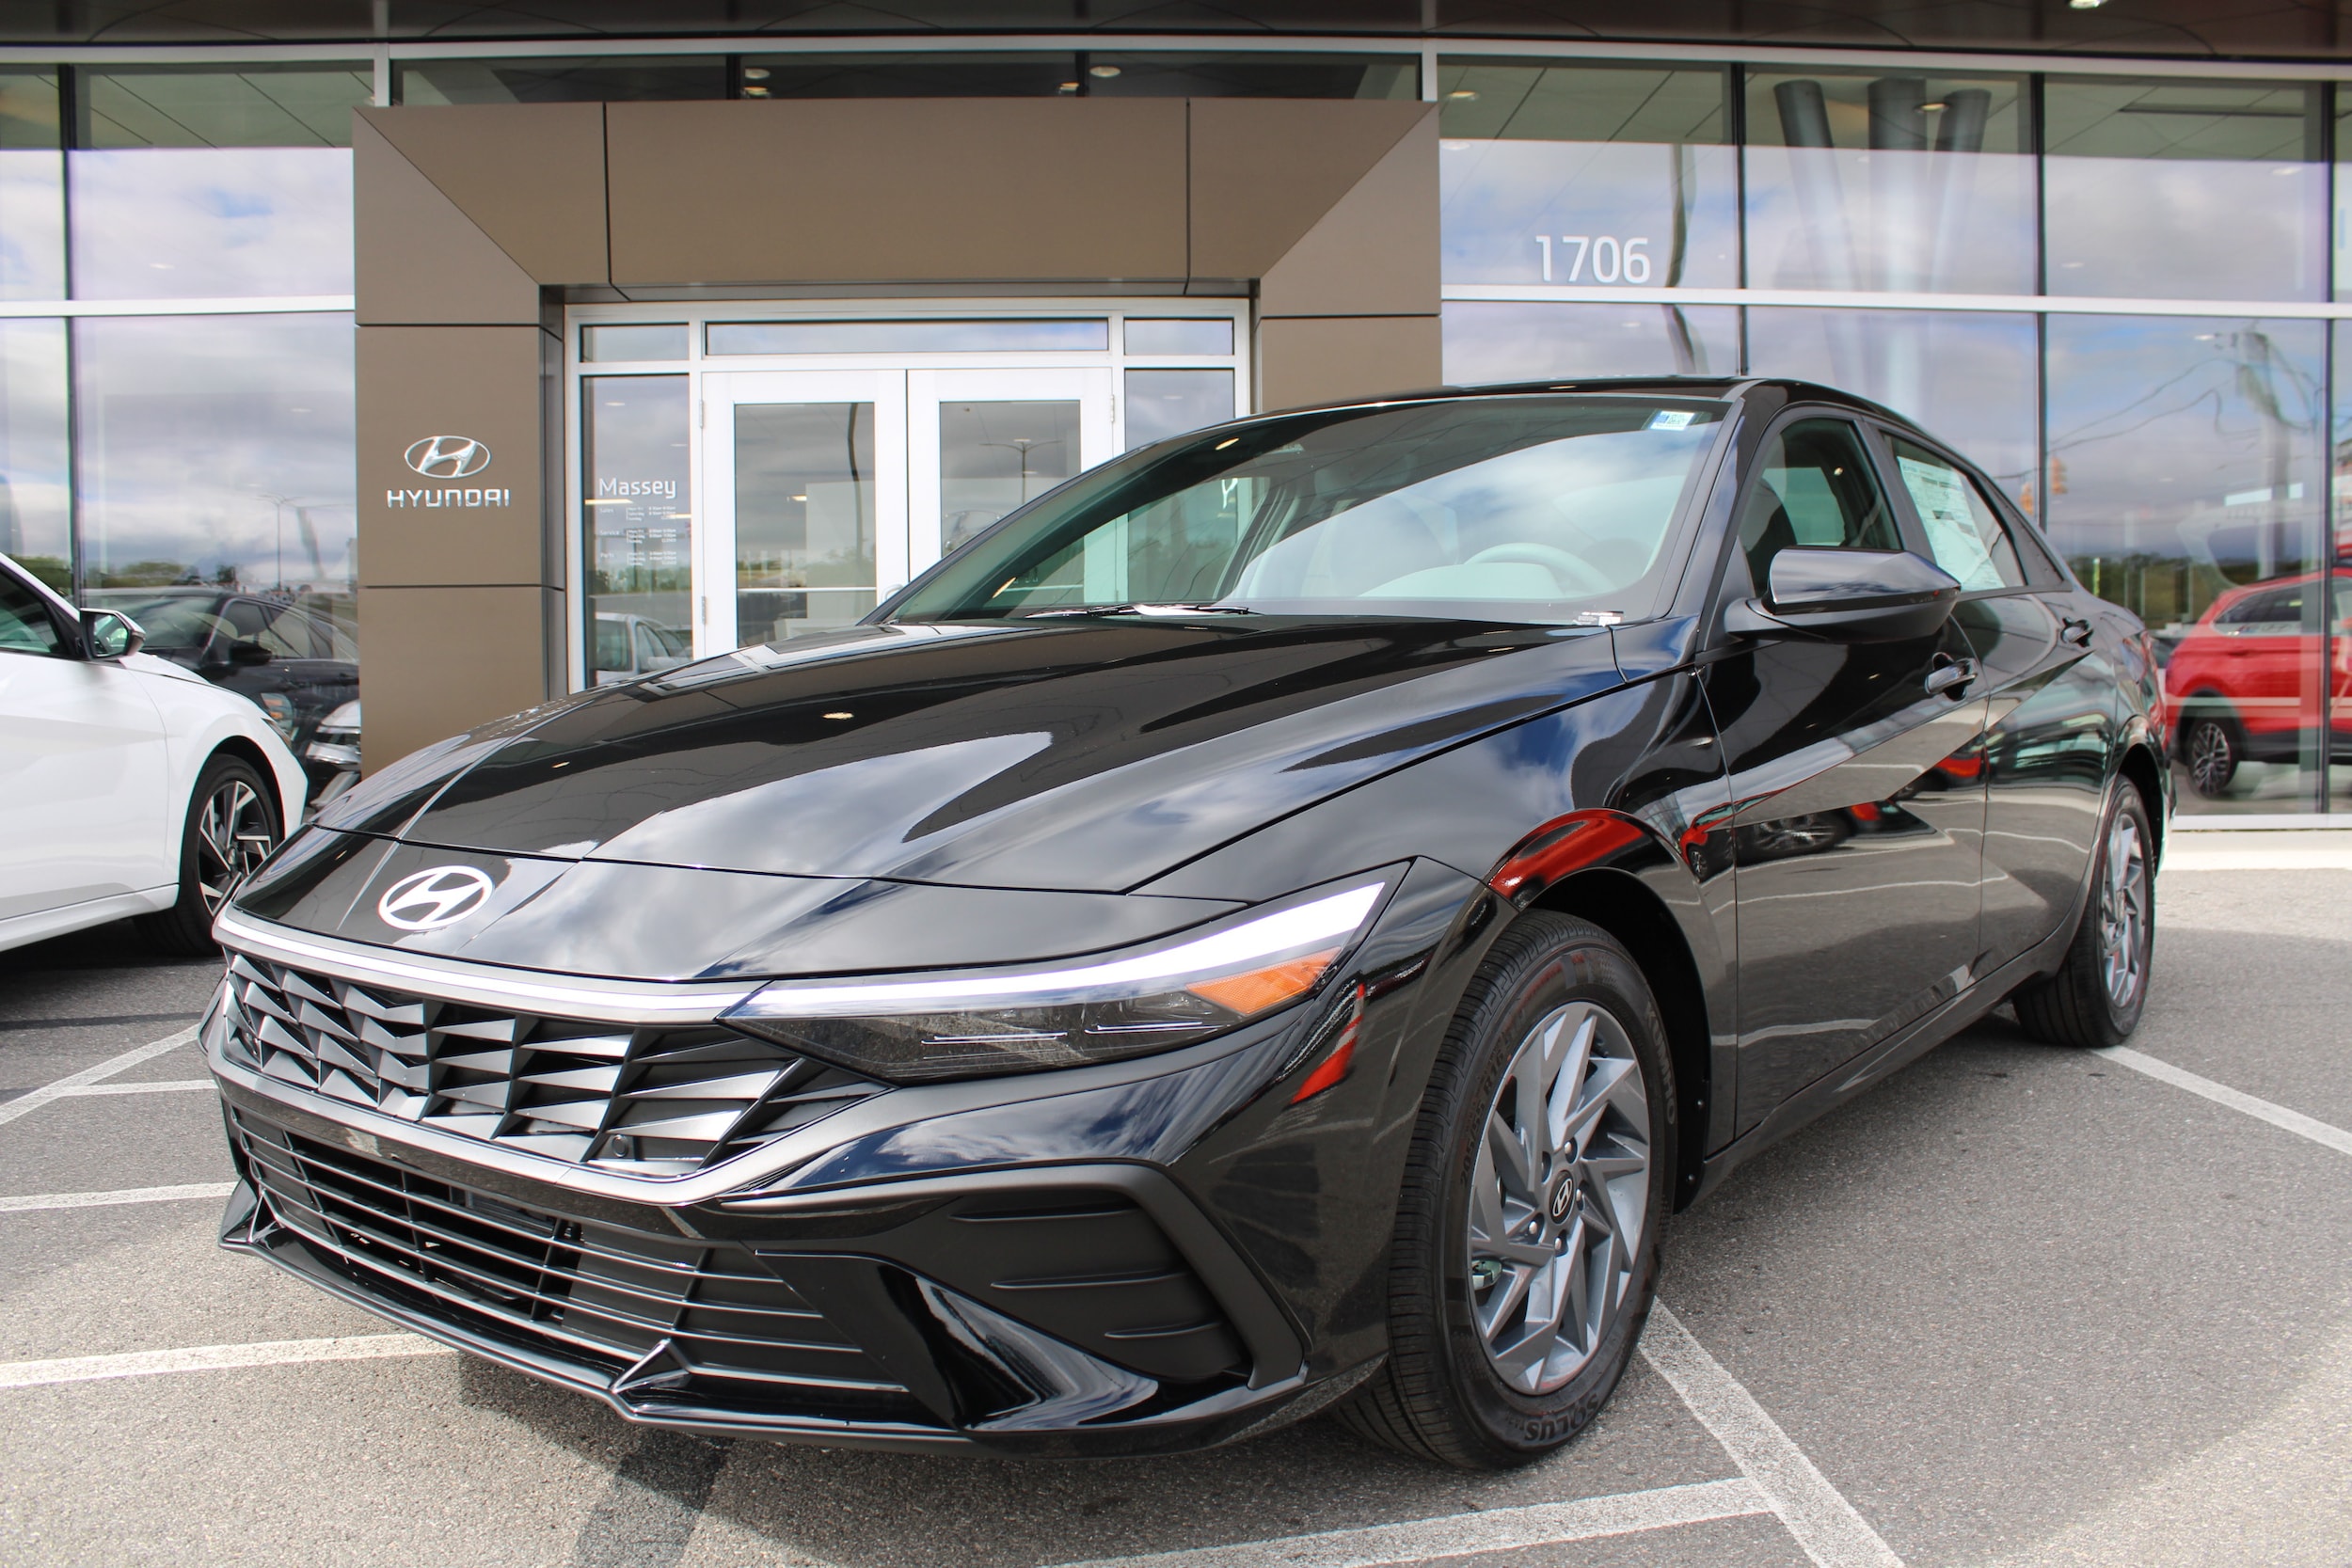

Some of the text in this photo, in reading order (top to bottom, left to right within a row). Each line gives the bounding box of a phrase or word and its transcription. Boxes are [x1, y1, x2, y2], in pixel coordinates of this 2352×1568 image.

[1535, 235, 1651, 284] 1706
[387, 488, 511, 508] HYUNDAI
[598, 478, 676, 499] Massey
[1645, 1000, 1676, 1125] KUMHO
[1459, 1101, 1486, 1188] 205/55
[1524, 1392, 1599, 1441] SOLUS
